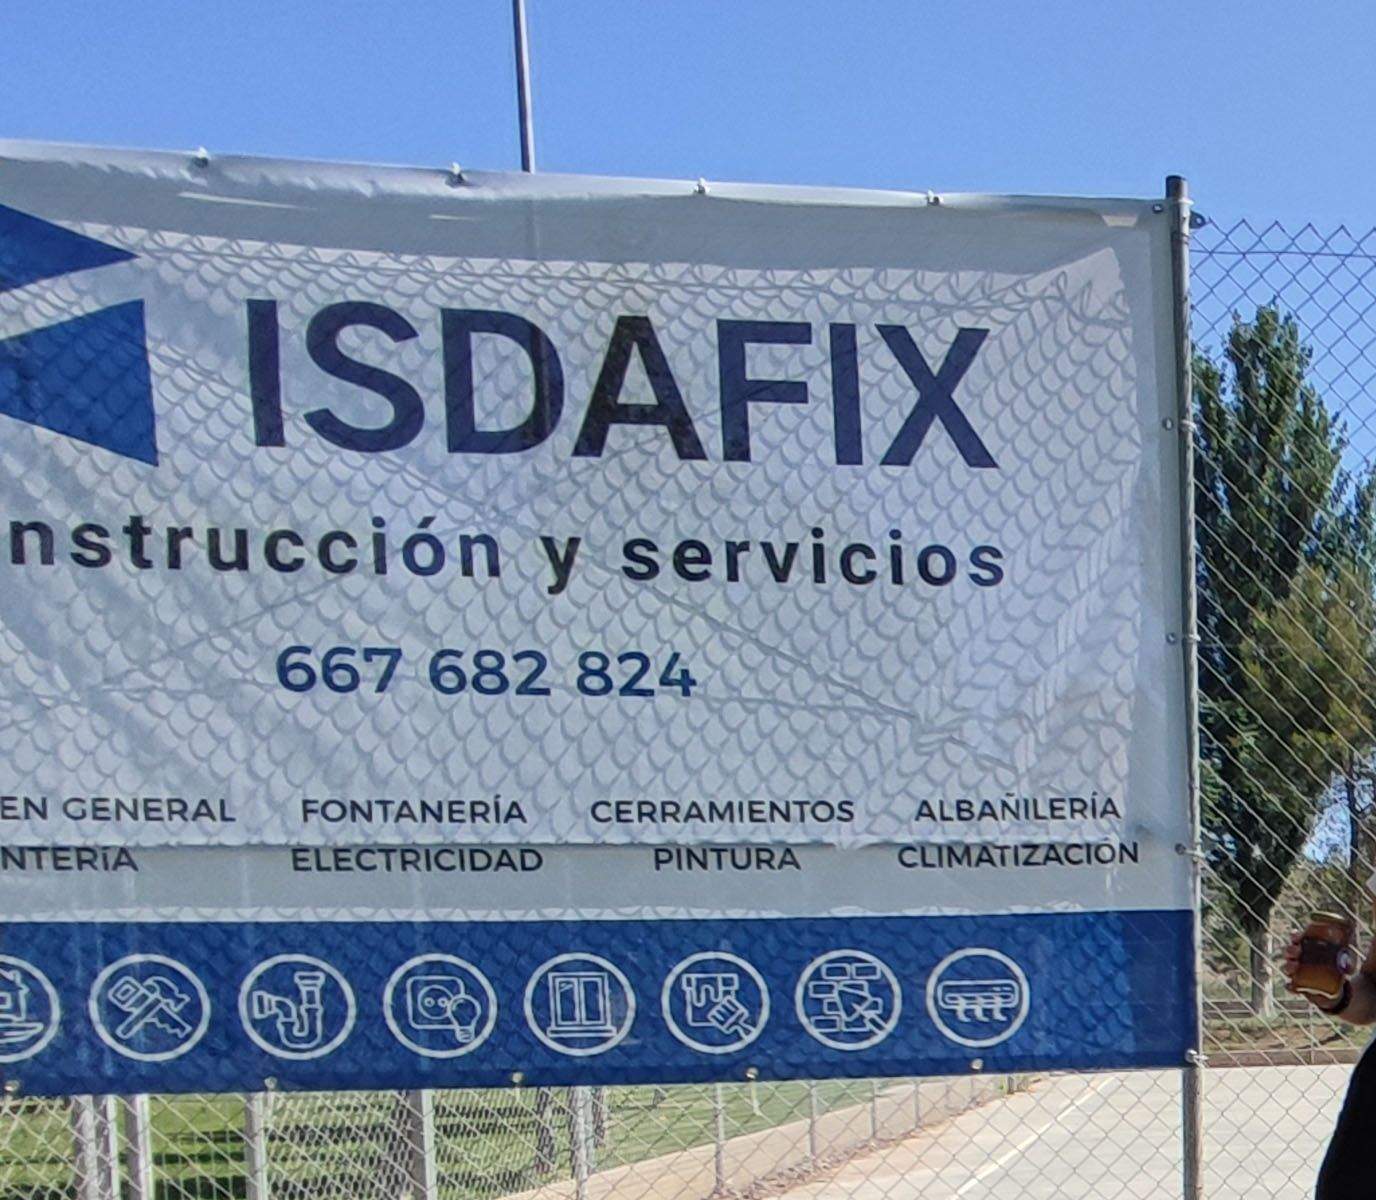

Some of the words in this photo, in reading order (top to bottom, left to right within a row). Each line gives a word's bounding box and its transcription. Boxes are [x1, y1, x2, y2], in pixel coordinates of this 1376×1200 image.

[246, 298, 1000, 469] ISDAFIX
[9, 515, 500, 577] nstrucción
[539, 535, 582, 595] y
[621, 527, 1005, 587] servicios
[276, 646, 402, 694] 667
[428, 649, 551, 697] 682
[576, 650, 697, 698] 824
[0, 796, 48, 821] EN
[62, 797, 236, 822] GENERAL
[302, 794, 527, 824] FONTANERÍA
[590, 799, 855, 824] CERRAMIENTOS
[914, 791, 1122, 822] ALBAÑILERÍA
[291, 847, 544, 873] ELECTRICIDAD
[654, 847, 801, 872] PINTURA
[897, 836, 1140, 869] CLIMATIZACIÓN
